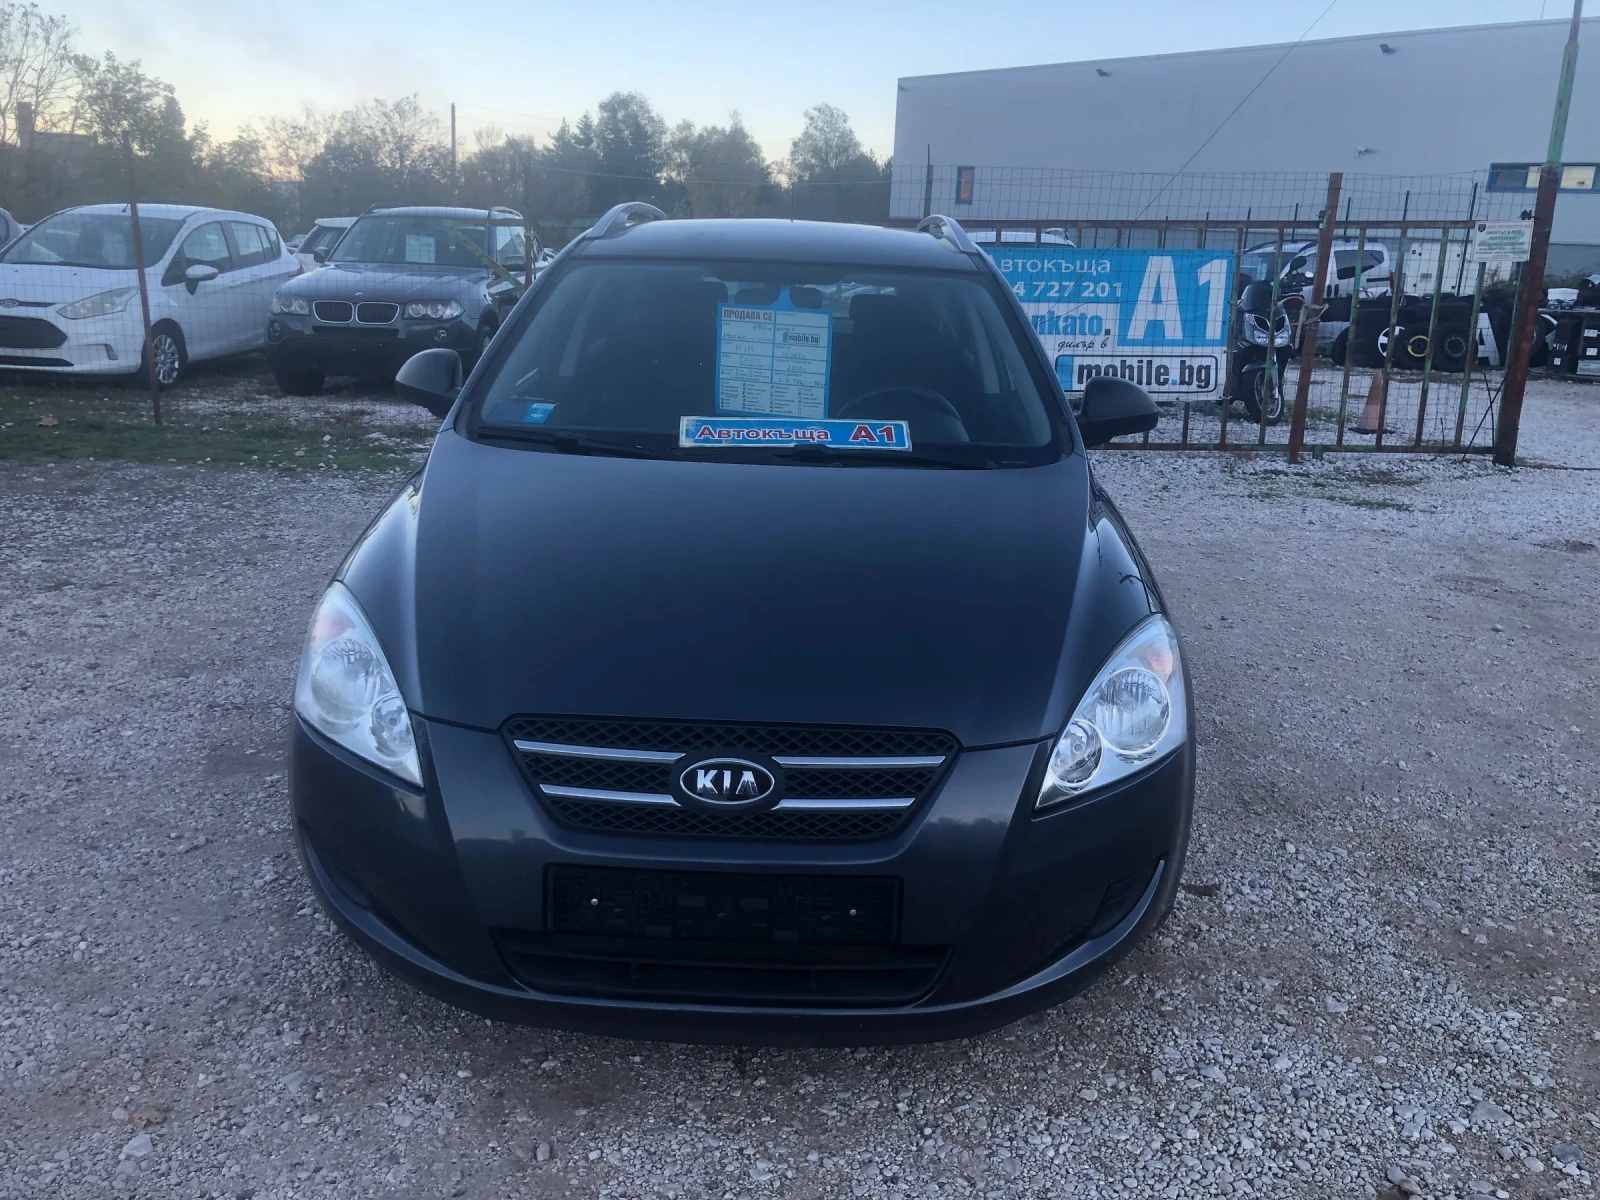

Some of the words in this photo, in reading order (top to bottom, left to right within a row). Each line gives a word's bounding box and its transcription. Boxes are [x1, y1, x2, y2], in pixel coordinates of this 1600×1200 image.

[1032, 281, 1075, 297] 727
[1080, 281, 1122, 297] 201
[1126, 255, 1228, 340] A1
[723, 309, 761, 321] ПРОДАВА
[762, 311, 773, 322] СЕ
[787, 334, 819, 344] mobile.bg
[697, 425, 831, 442] Автокъща
[850, 424, 898, 443] A1
[696, 769, 759, 795] KIA
